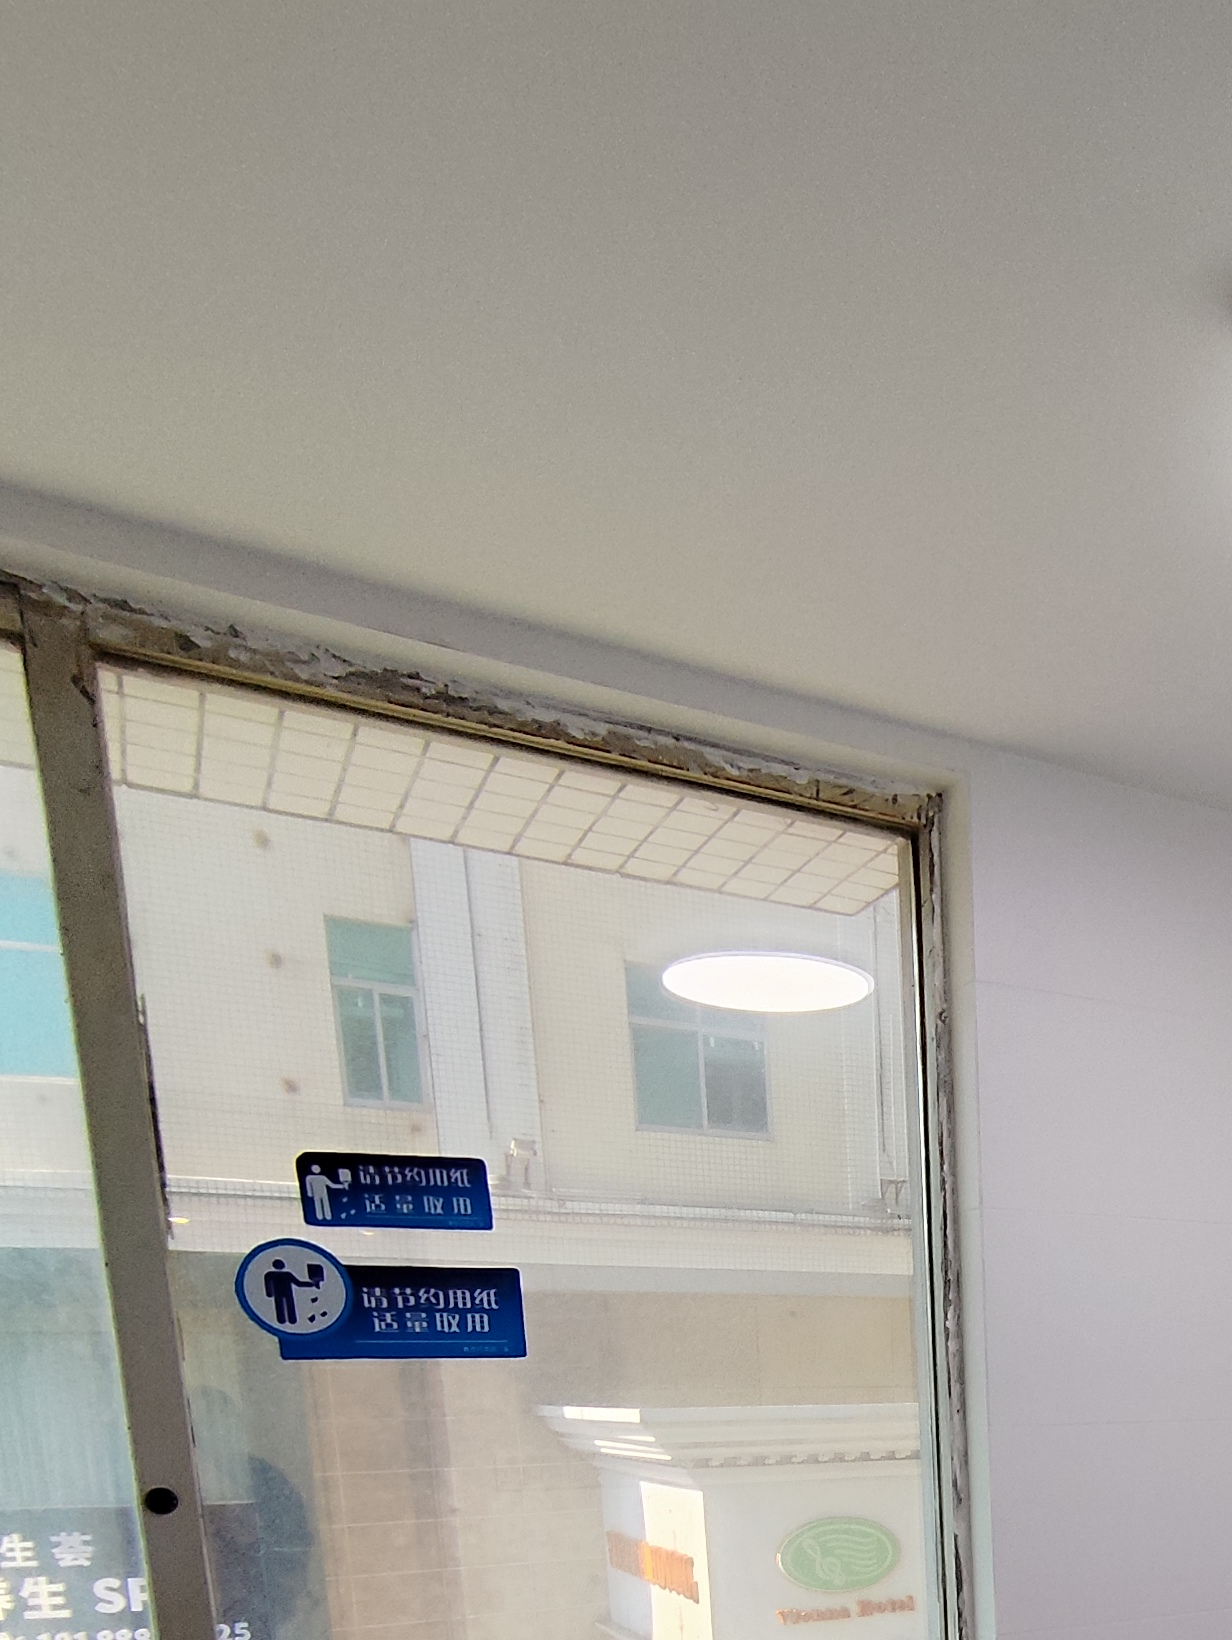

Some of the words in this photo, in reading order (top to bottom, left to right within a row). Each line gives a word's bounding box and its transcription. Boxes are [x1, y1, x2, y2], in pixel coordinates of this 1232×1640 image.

[358, 1165, 472, 1188] 请节约用纸
[364, 1193, 473, 1215] 适量取用
[361, 1286, 500, 1310] 请节约用纸
[372, 1311, 490, 1333] 适量取用
